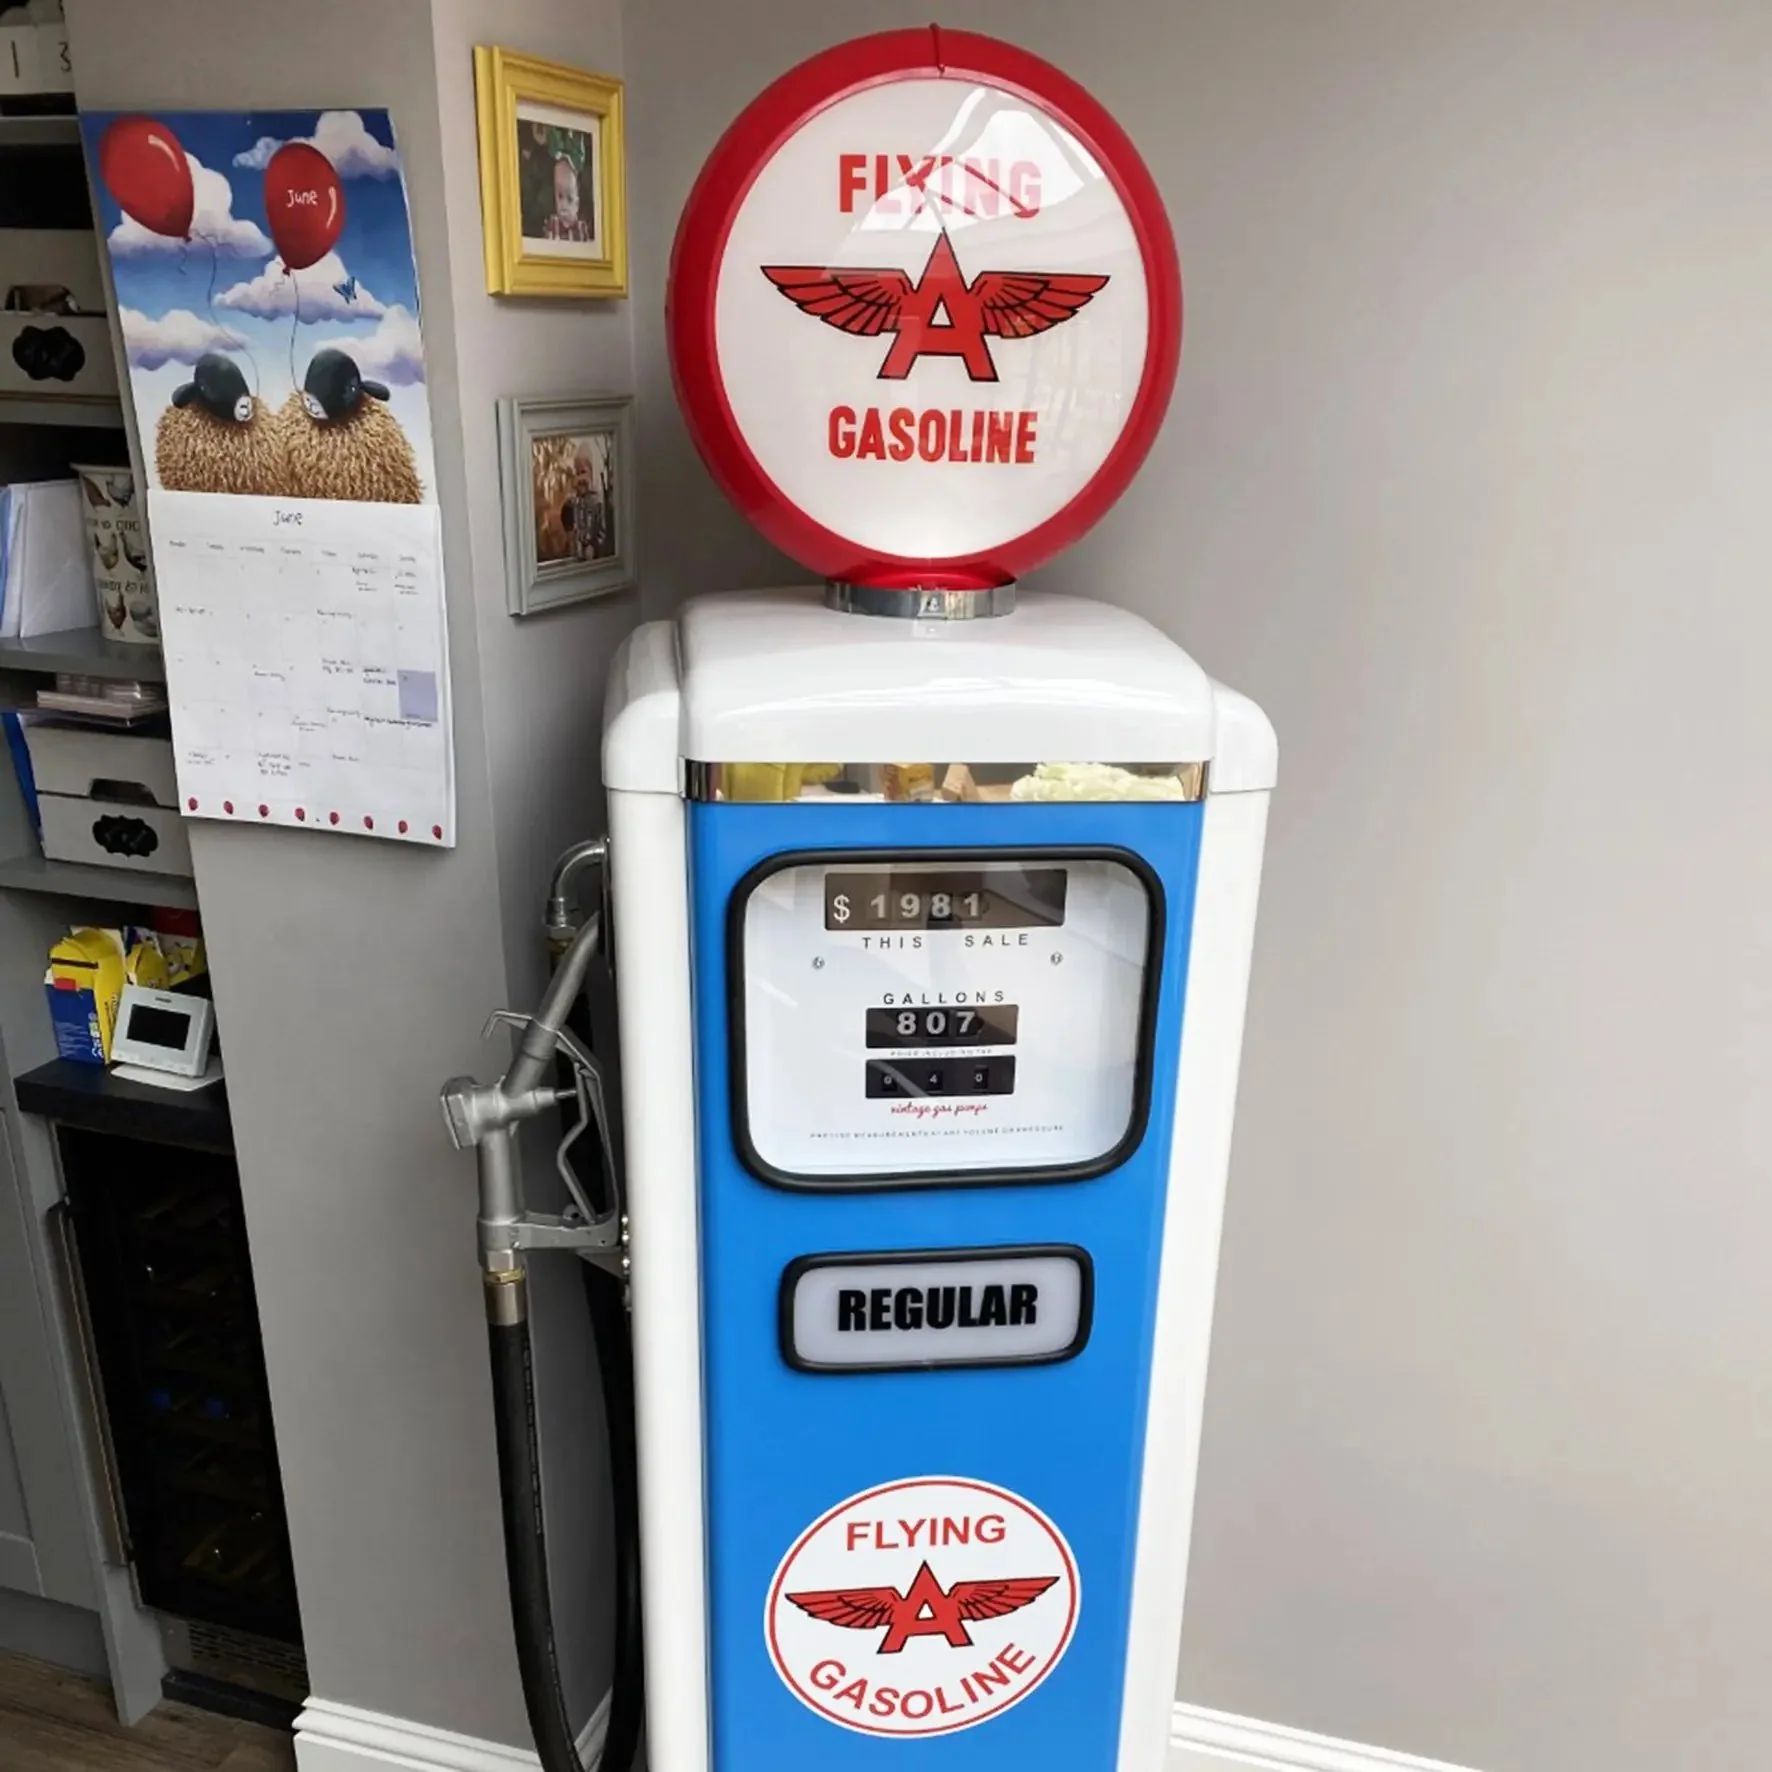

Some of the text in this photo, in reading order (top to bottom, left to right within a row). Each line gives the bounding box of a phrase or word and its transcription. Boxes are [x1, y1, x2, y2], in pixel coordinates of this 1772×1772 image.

[58, 41, 72, 73] 3
[286, 189, 318, 208] June
[839, 154, 1042, 218] FLYING
[828, 406, 1037, 464] GASOLINE
[833, 893, 979, 923] $ 1981
[862, 933, 1028, 949] THIS SALE
[883, 991, 1004, 1004] GALLONS
[896, 1011, 975, 1035] 807
[891, 1101, 930, 1119] vintage
[932, 1104, 952, 1119] gas
[837, 1283, 1039, 1332] REGULAR
[846, 1514, 1007, 1551] FLYING
[809, 1642, 1036, 1719] GASOLINE
